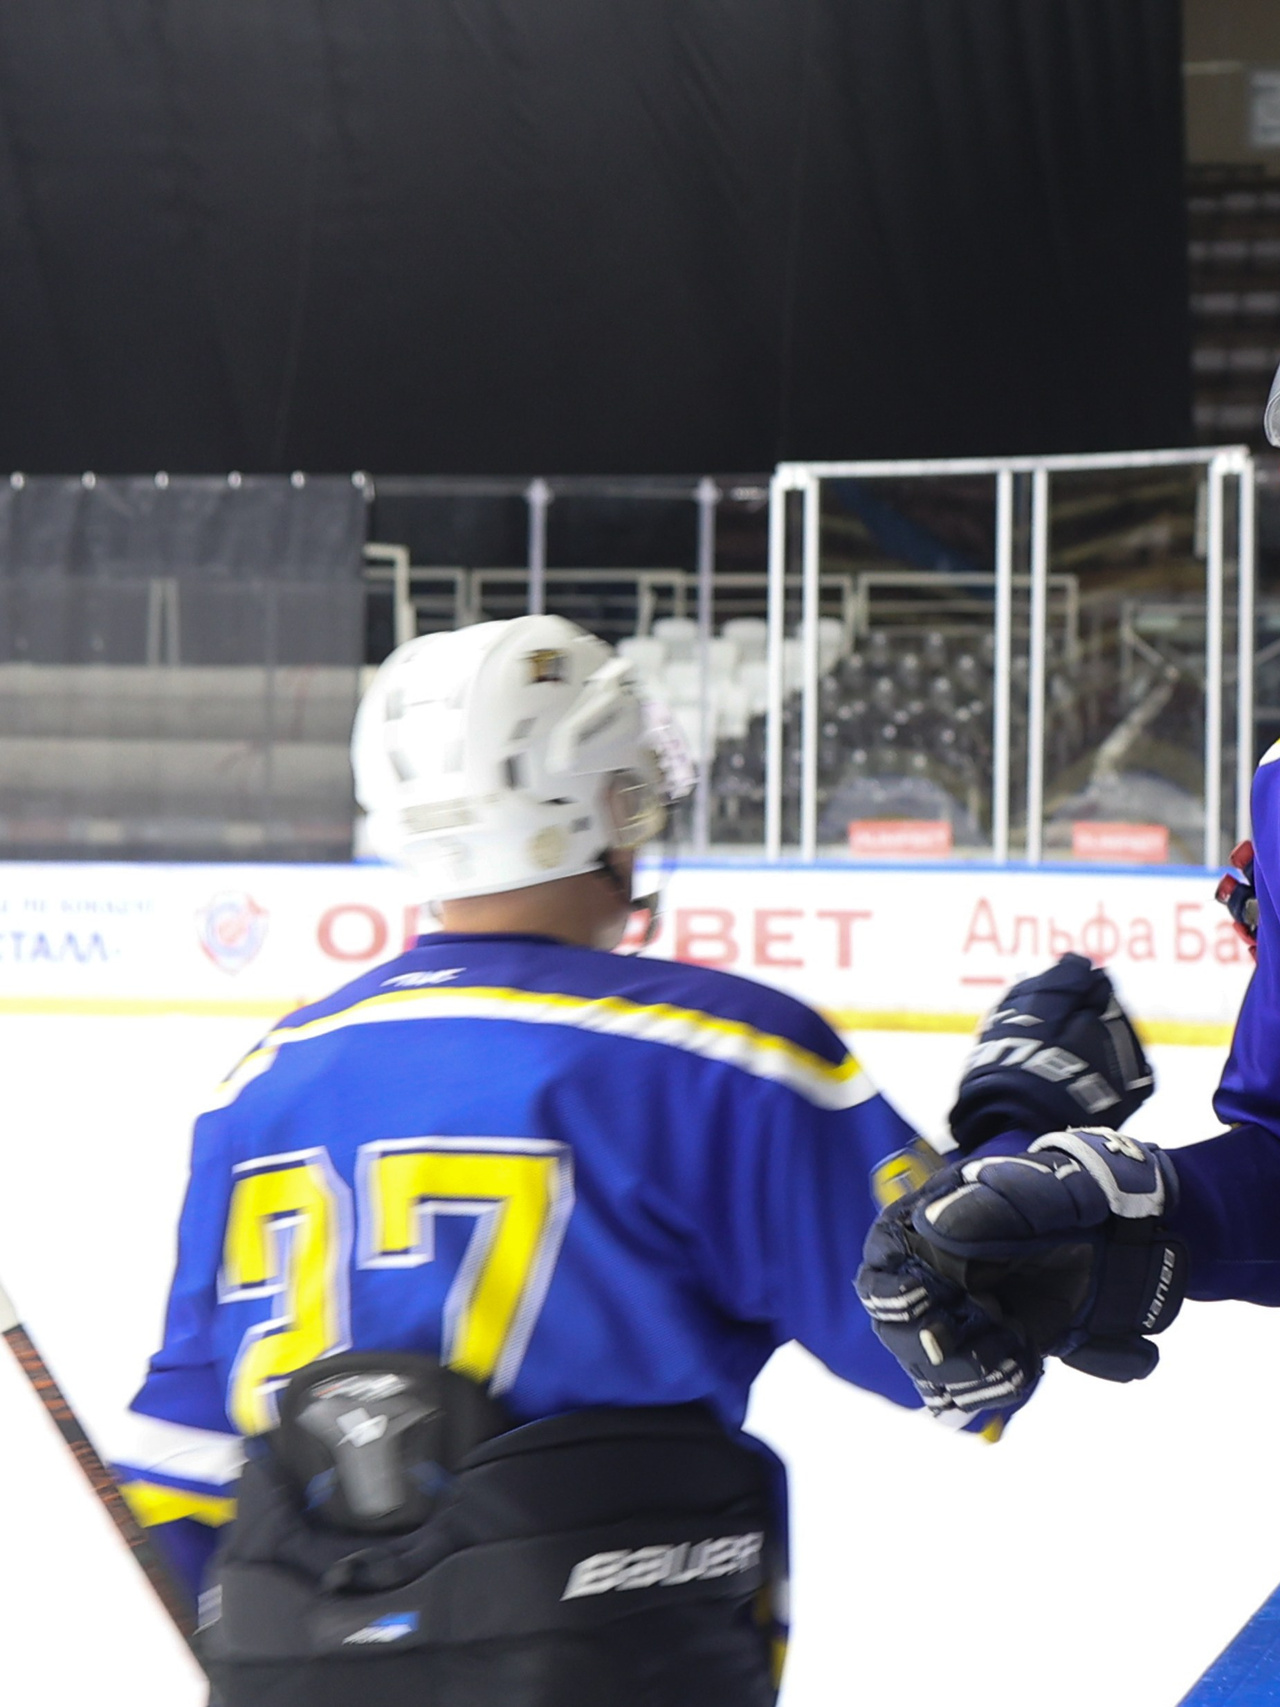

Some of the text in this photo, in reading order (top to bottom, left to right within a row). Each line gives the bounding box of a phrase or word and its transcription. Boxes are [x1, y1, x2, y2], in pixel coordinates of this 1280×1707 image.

[962, 896, 1255, 967] Альфа Ба
[1142, 1247, 1176, 1329] BAUER
[559, 1531, 765, 1602] BAUER
